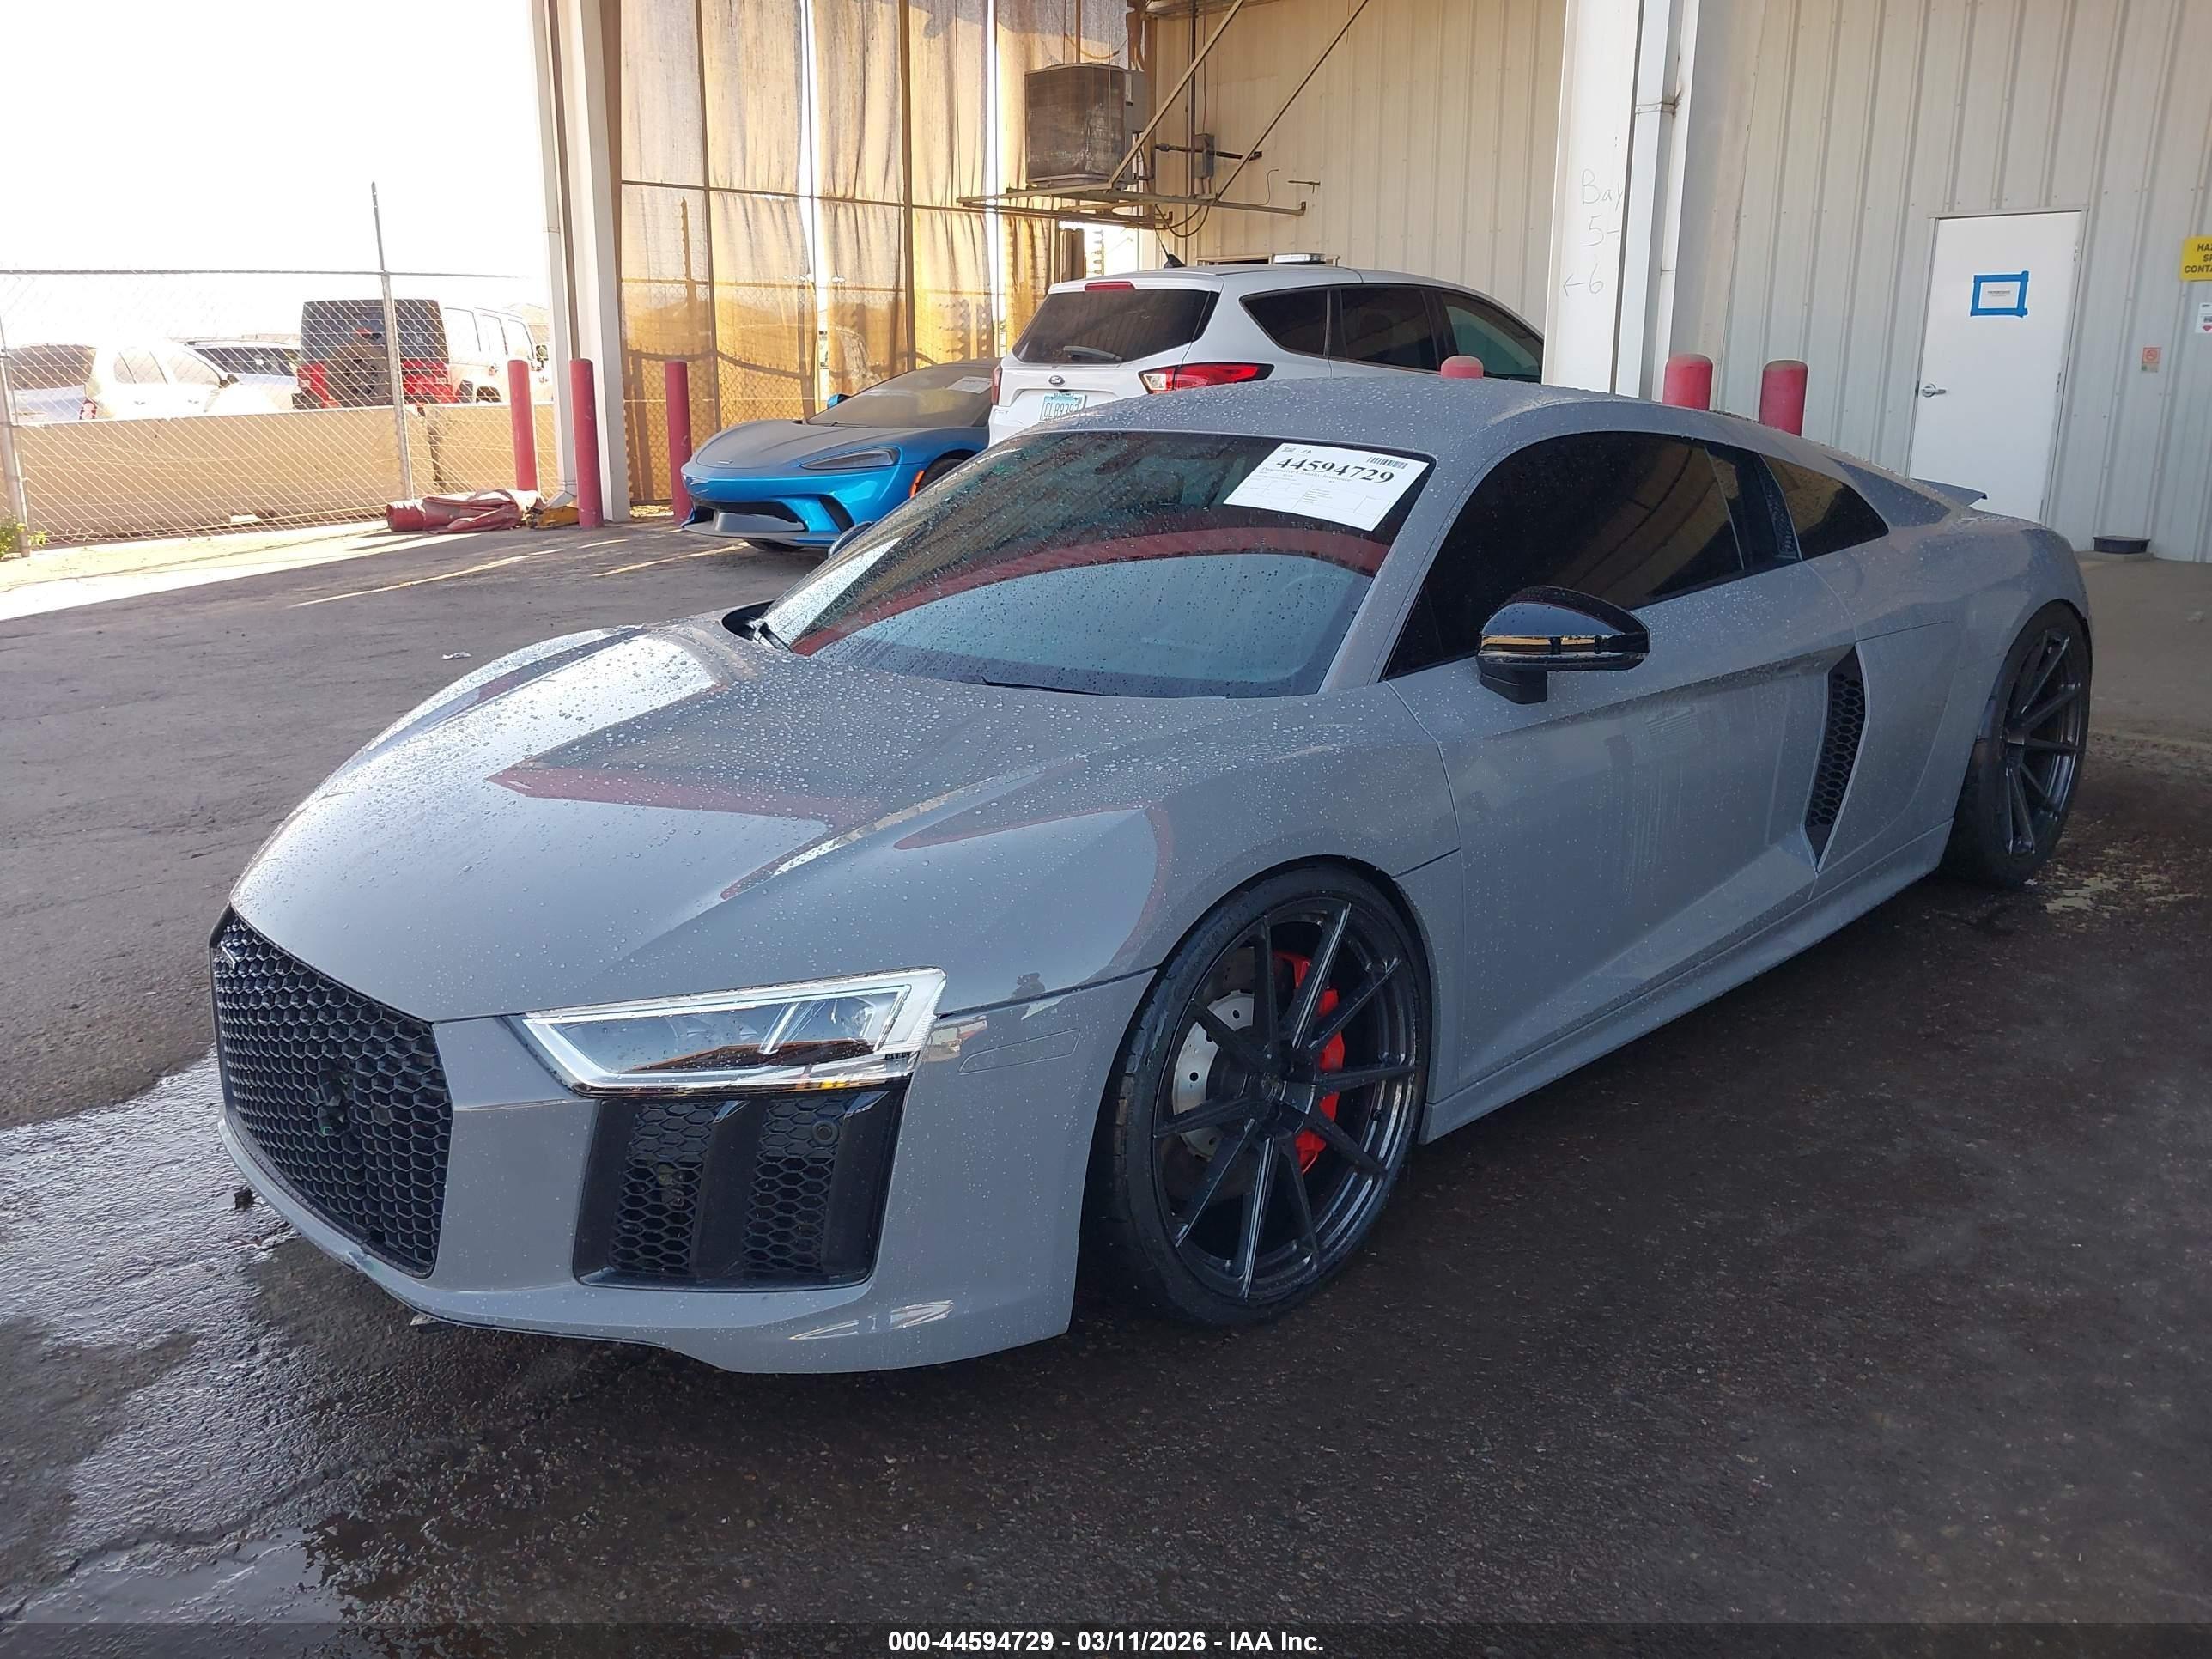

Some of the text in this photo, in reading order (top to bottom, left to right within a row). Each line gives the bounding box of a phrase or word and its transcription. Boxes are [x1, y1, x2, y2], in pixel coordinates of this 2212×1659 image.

[1582, 168, 1623, 211] Bay
[2197, 243, 2212, 252] HA
[1276, 457, 1395, 483] 44594729
